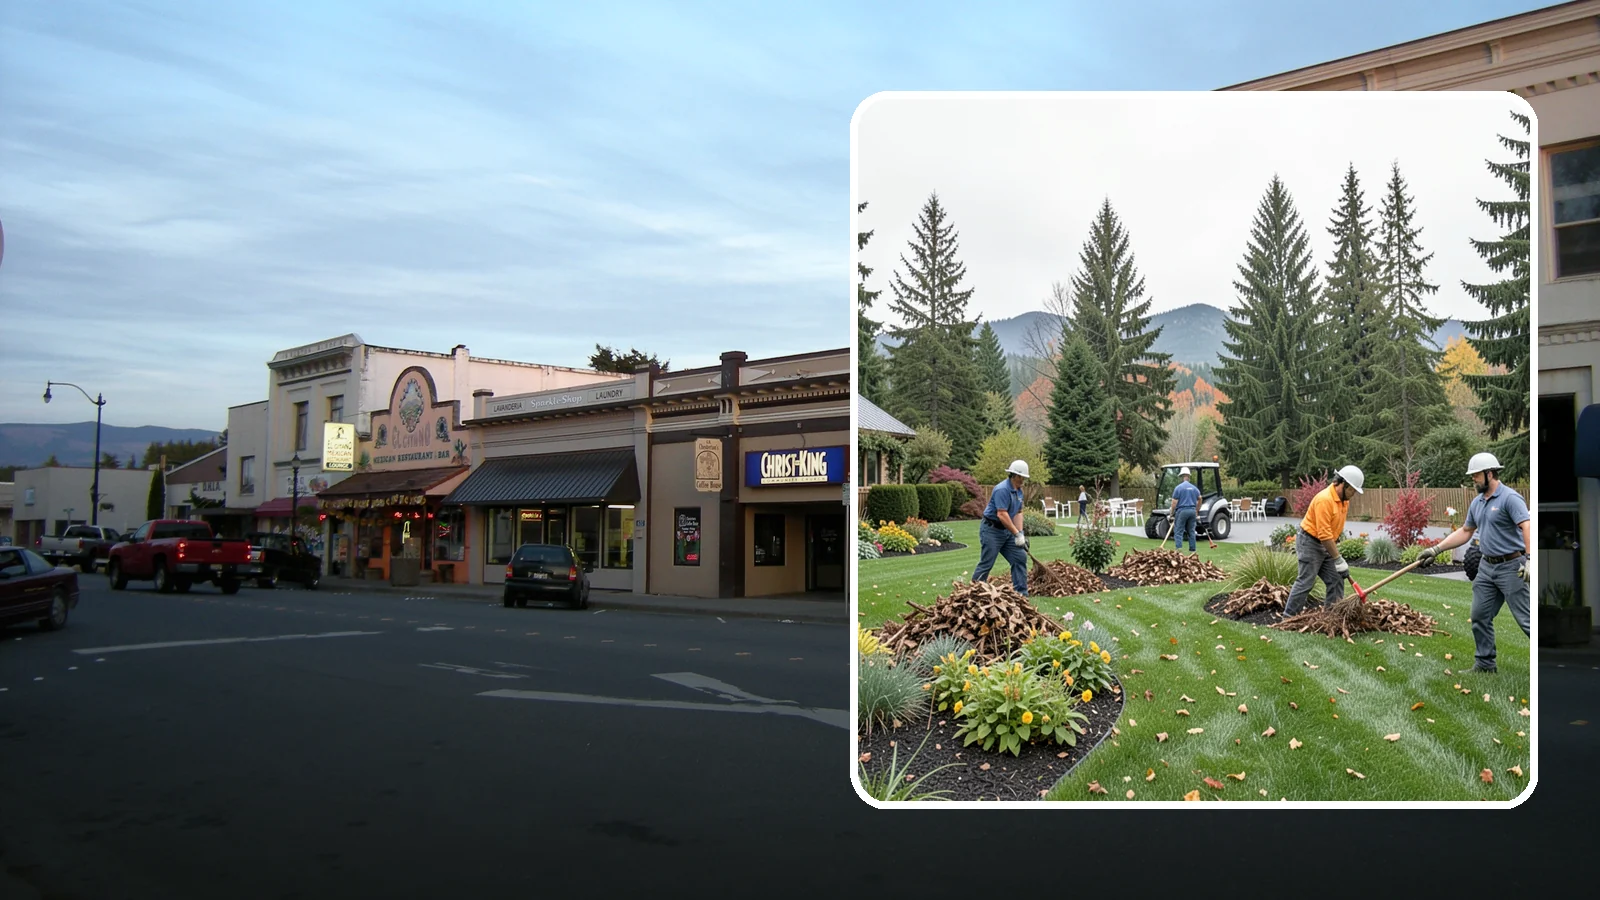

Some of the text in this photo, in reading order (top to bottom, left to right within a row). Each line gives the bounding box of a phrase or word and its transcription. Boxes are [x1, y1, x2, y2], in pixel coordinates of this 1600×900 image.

[494, 402, 522, 412] LAVANDERIA
[562, 394, 582, 404] Shop
[595, 389, 624, 400] LAUNDRY
[373, 450, 450, 464] MEXICAN RESTAURANT BAR
[761, 450, 828, 478] CHRIST KING
